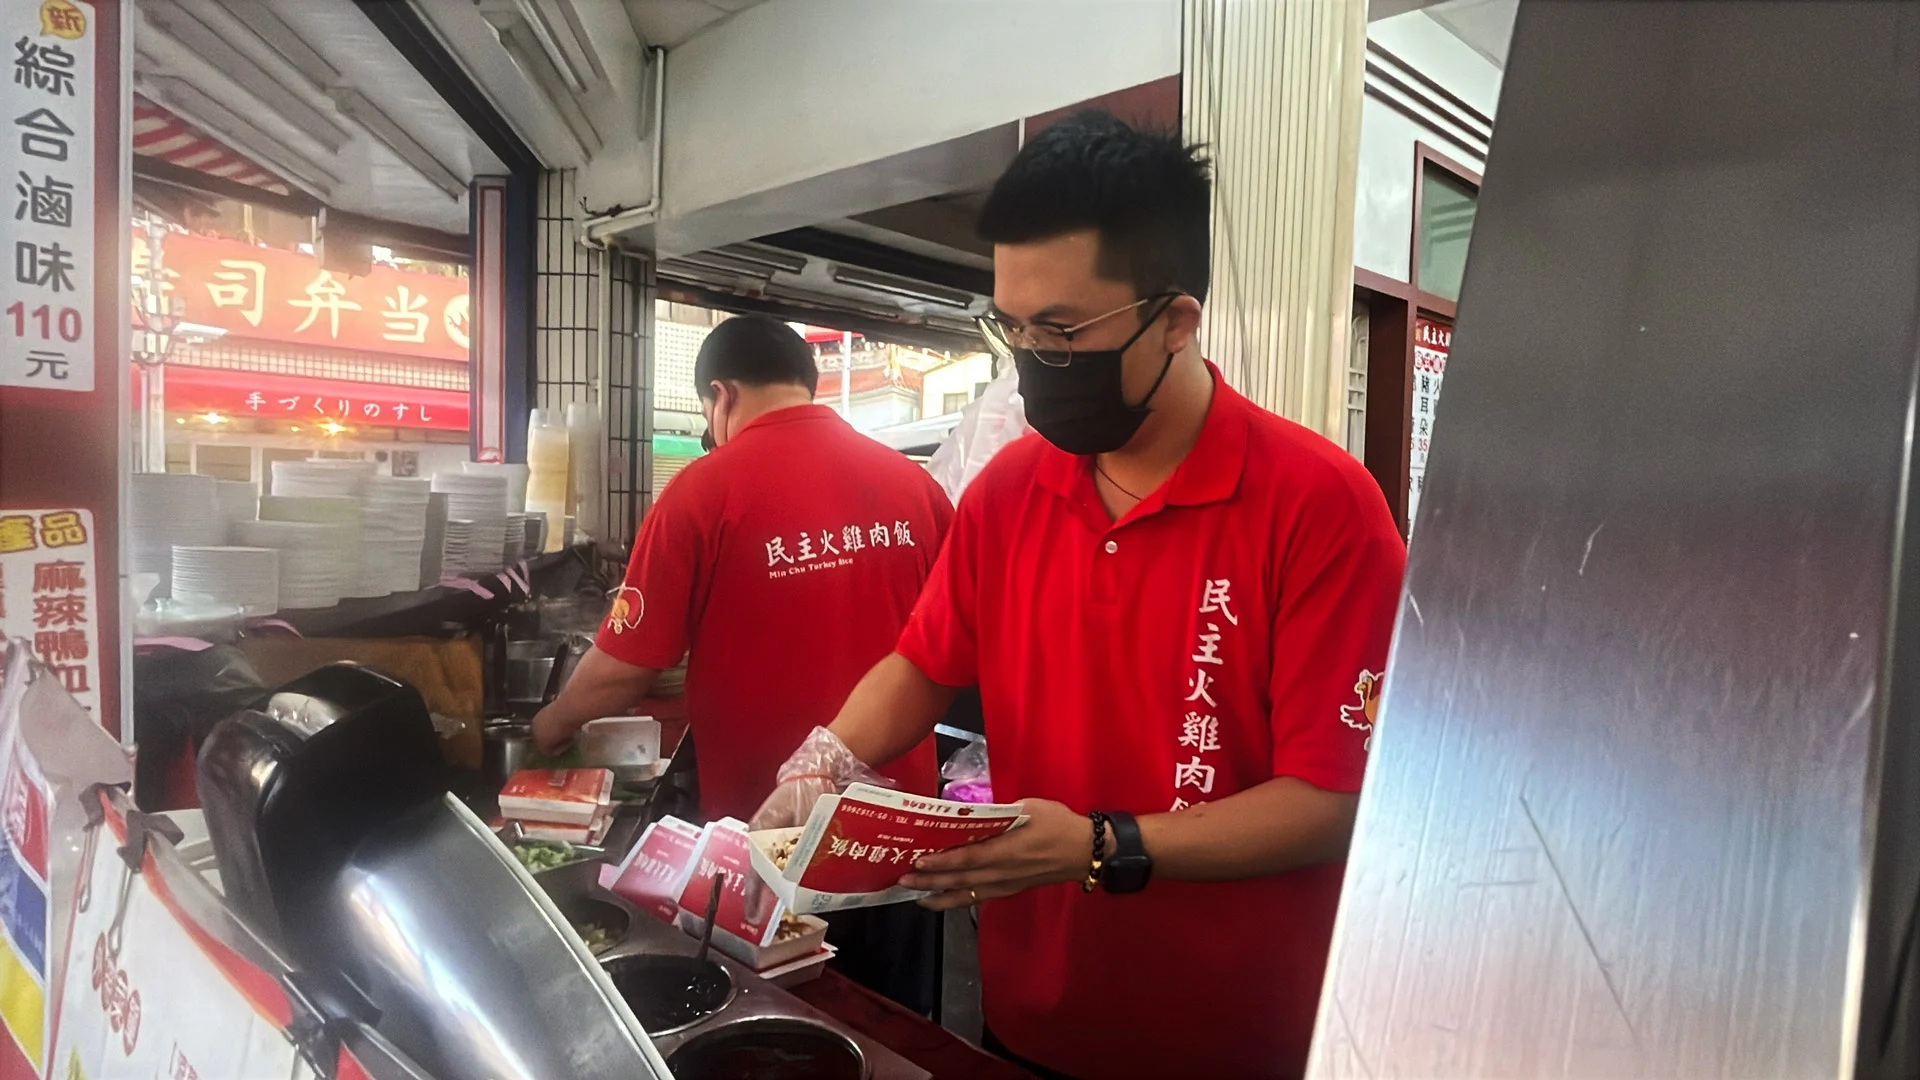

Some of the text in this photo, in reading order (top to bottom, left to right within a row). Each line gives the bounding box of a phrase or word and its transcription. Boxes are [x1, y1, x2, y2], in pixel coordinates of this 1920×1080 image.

[6, 35, 83, 380] 綜合滷味 110 元
[244, 391, 434, 422] 手づくりのすし
[1418, 438, 1428, 452] 35
[765, 520, 915, 567] 民主火雞肉飯
[769, 570, 787, 579] Min
[788, 566, 806, 576] Chu
[808, 559, 837, 572] Turkey
